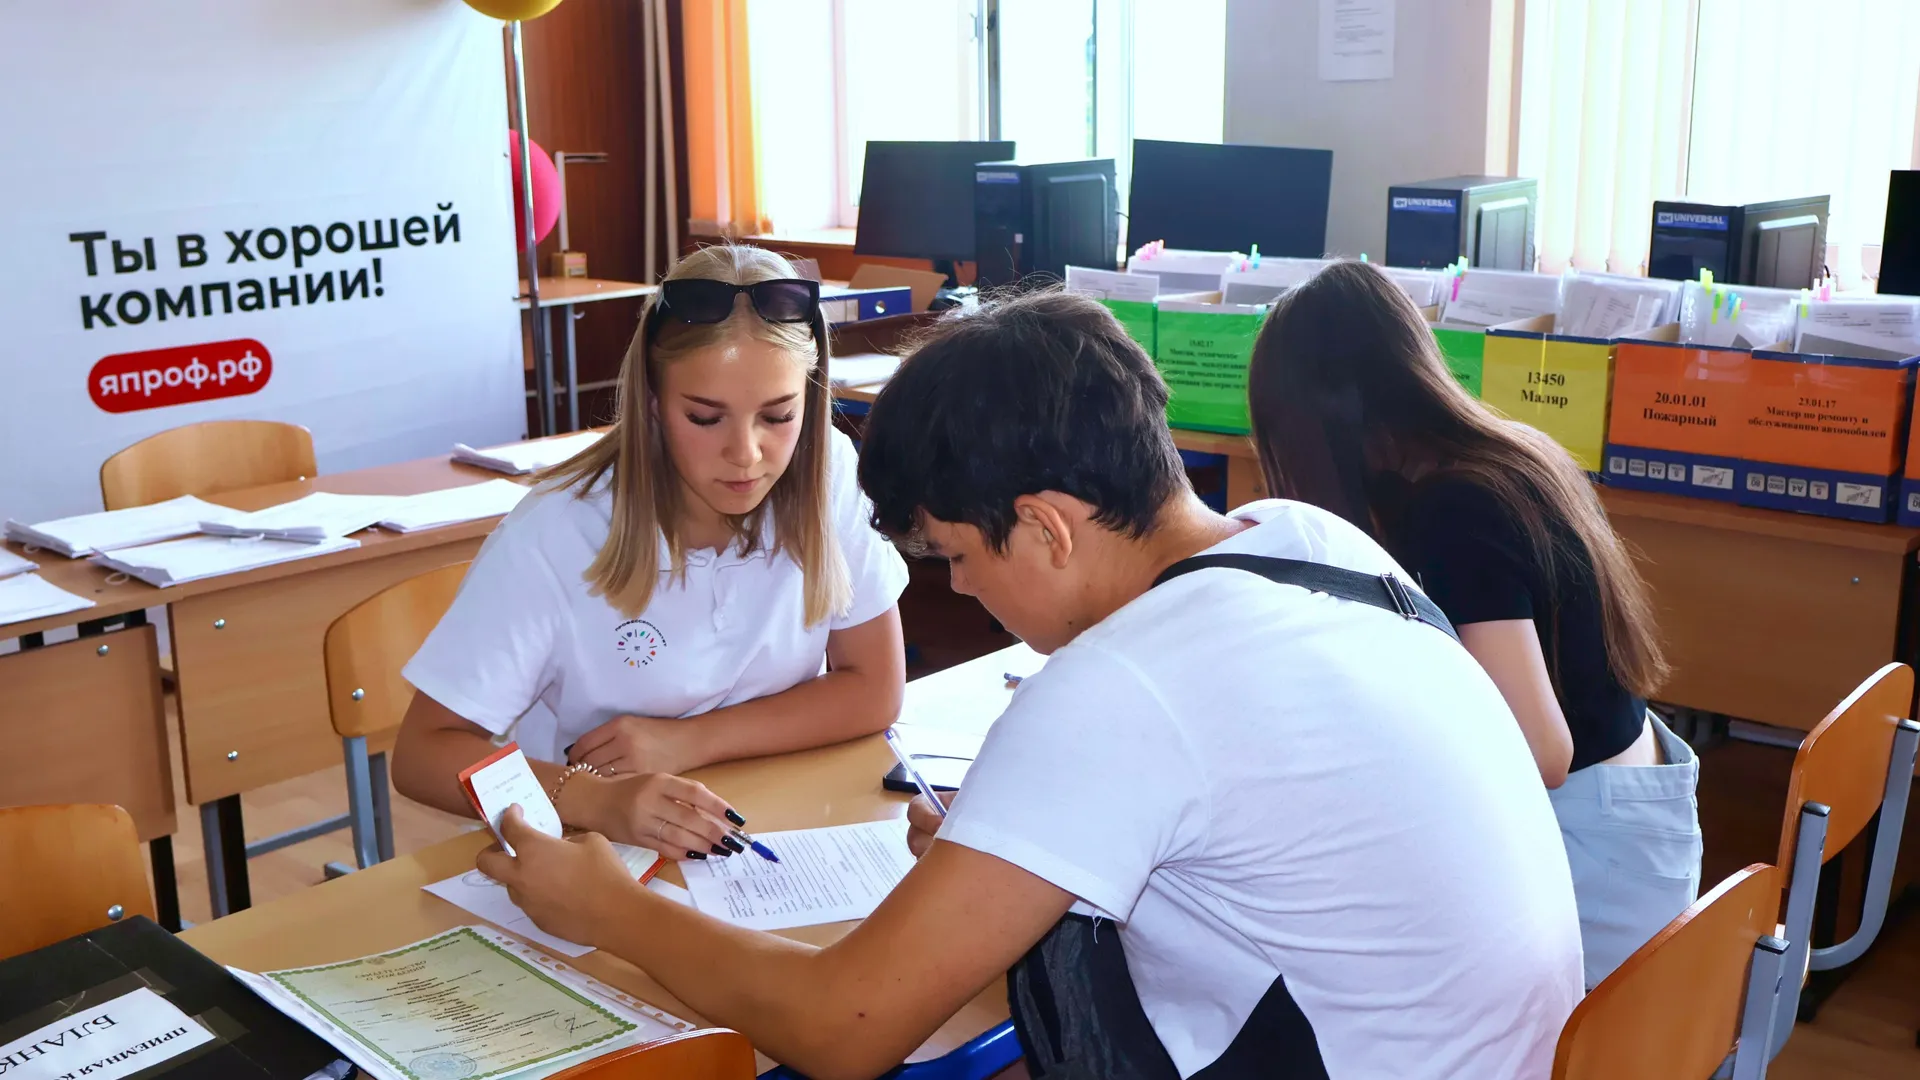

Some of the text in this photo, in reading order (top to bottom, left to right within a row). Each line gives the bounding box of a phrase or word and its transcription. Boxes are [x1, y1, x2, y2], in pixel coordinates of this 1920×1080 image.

[1407, 198, 1453, 208] UNIVERSAL
[1674, 213, 1725, 225] UNIVERSAL
[69, 202, 462, 277] Ты в хорошей
[80, 257, 385, 329] компании!
[99, 350, 263, 396] япроф.рф
[1527, 371, 1565, 387] 13450
[1520, 389, 1568, 407] Маляр
[1654, 391, 1707, 409] 20.01.01
[1798, 397, 1837, 409] 23.01.17
[1643, 408, 1717, 428] Пожарный
[1766, 406, 1869, 426] Мастер по ремонту и
[1748, 417, 1886, 439] обслуживанию автомобилей
[1651, 467, 1662, 475] A4
[1792, 484, 1803, 493] A4
[79, 1027, 189, 1075] ПРИЕМНАЯ
